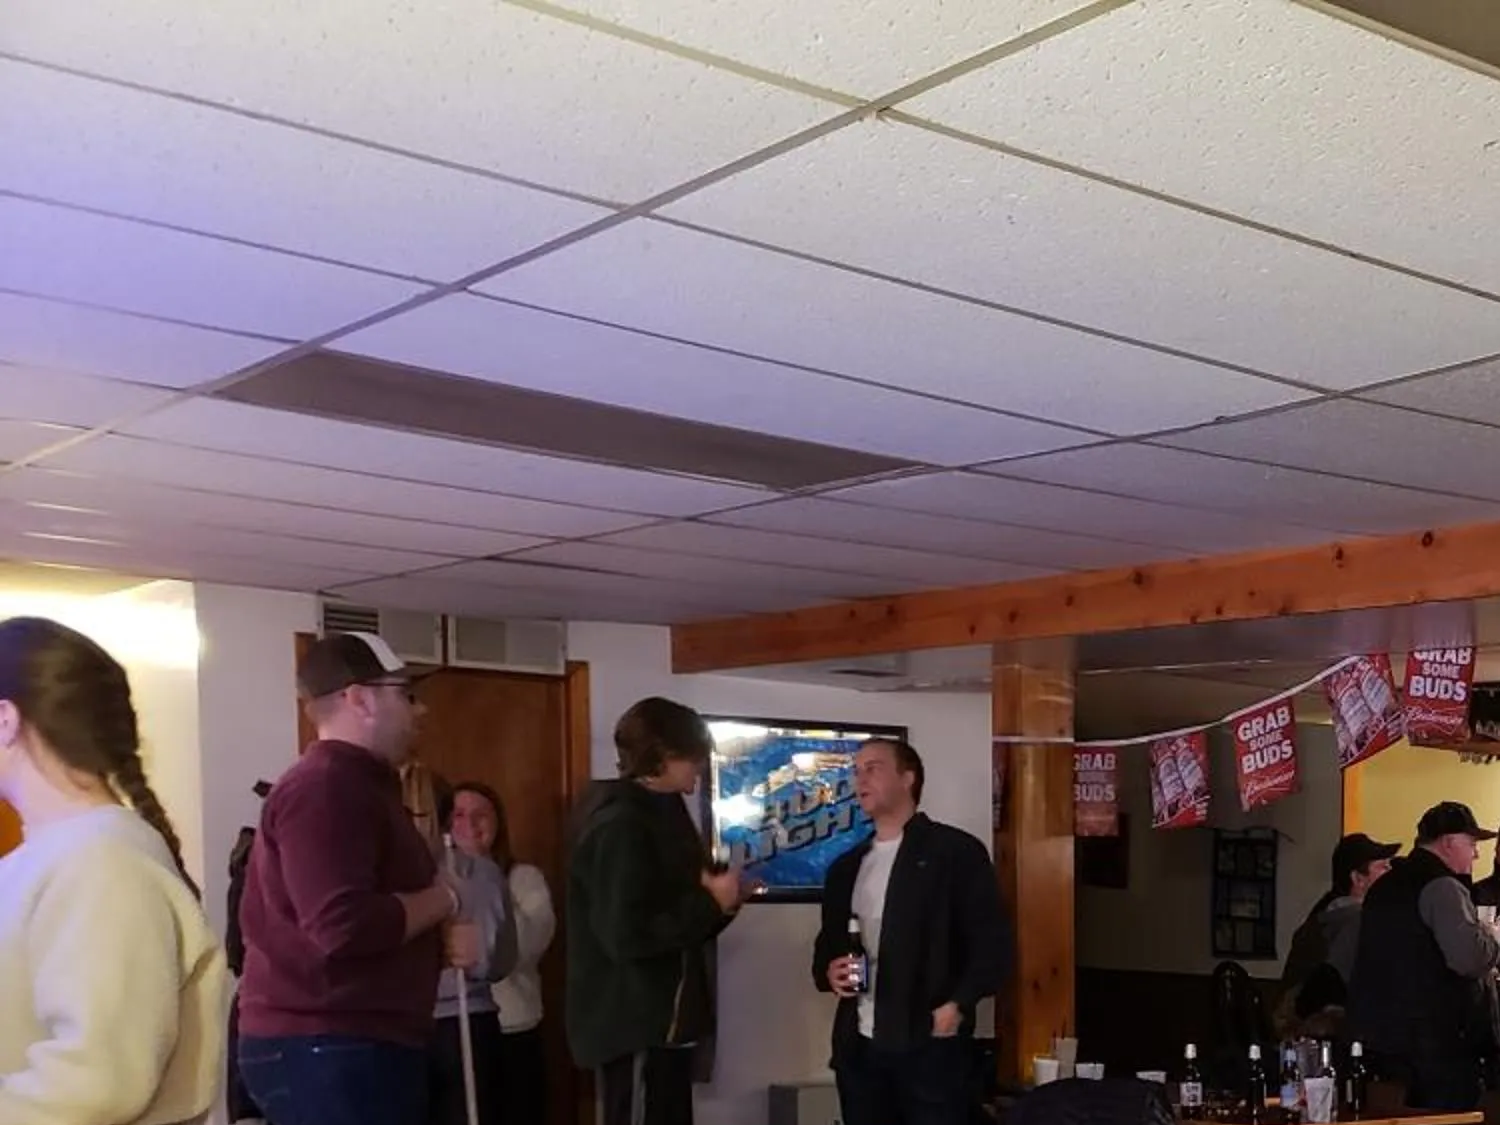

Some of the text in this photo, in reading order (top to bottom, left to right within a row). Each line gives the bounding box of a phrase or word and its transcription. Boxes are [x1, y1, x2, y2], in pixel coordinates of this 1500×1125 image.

[1423, 664, 1460, 679] SOME
[1409, 676, 1467, 701] BUDS
[1237, 706, 1290, 742] GRAB
[1242, 739, 1293, 774] BUDS
